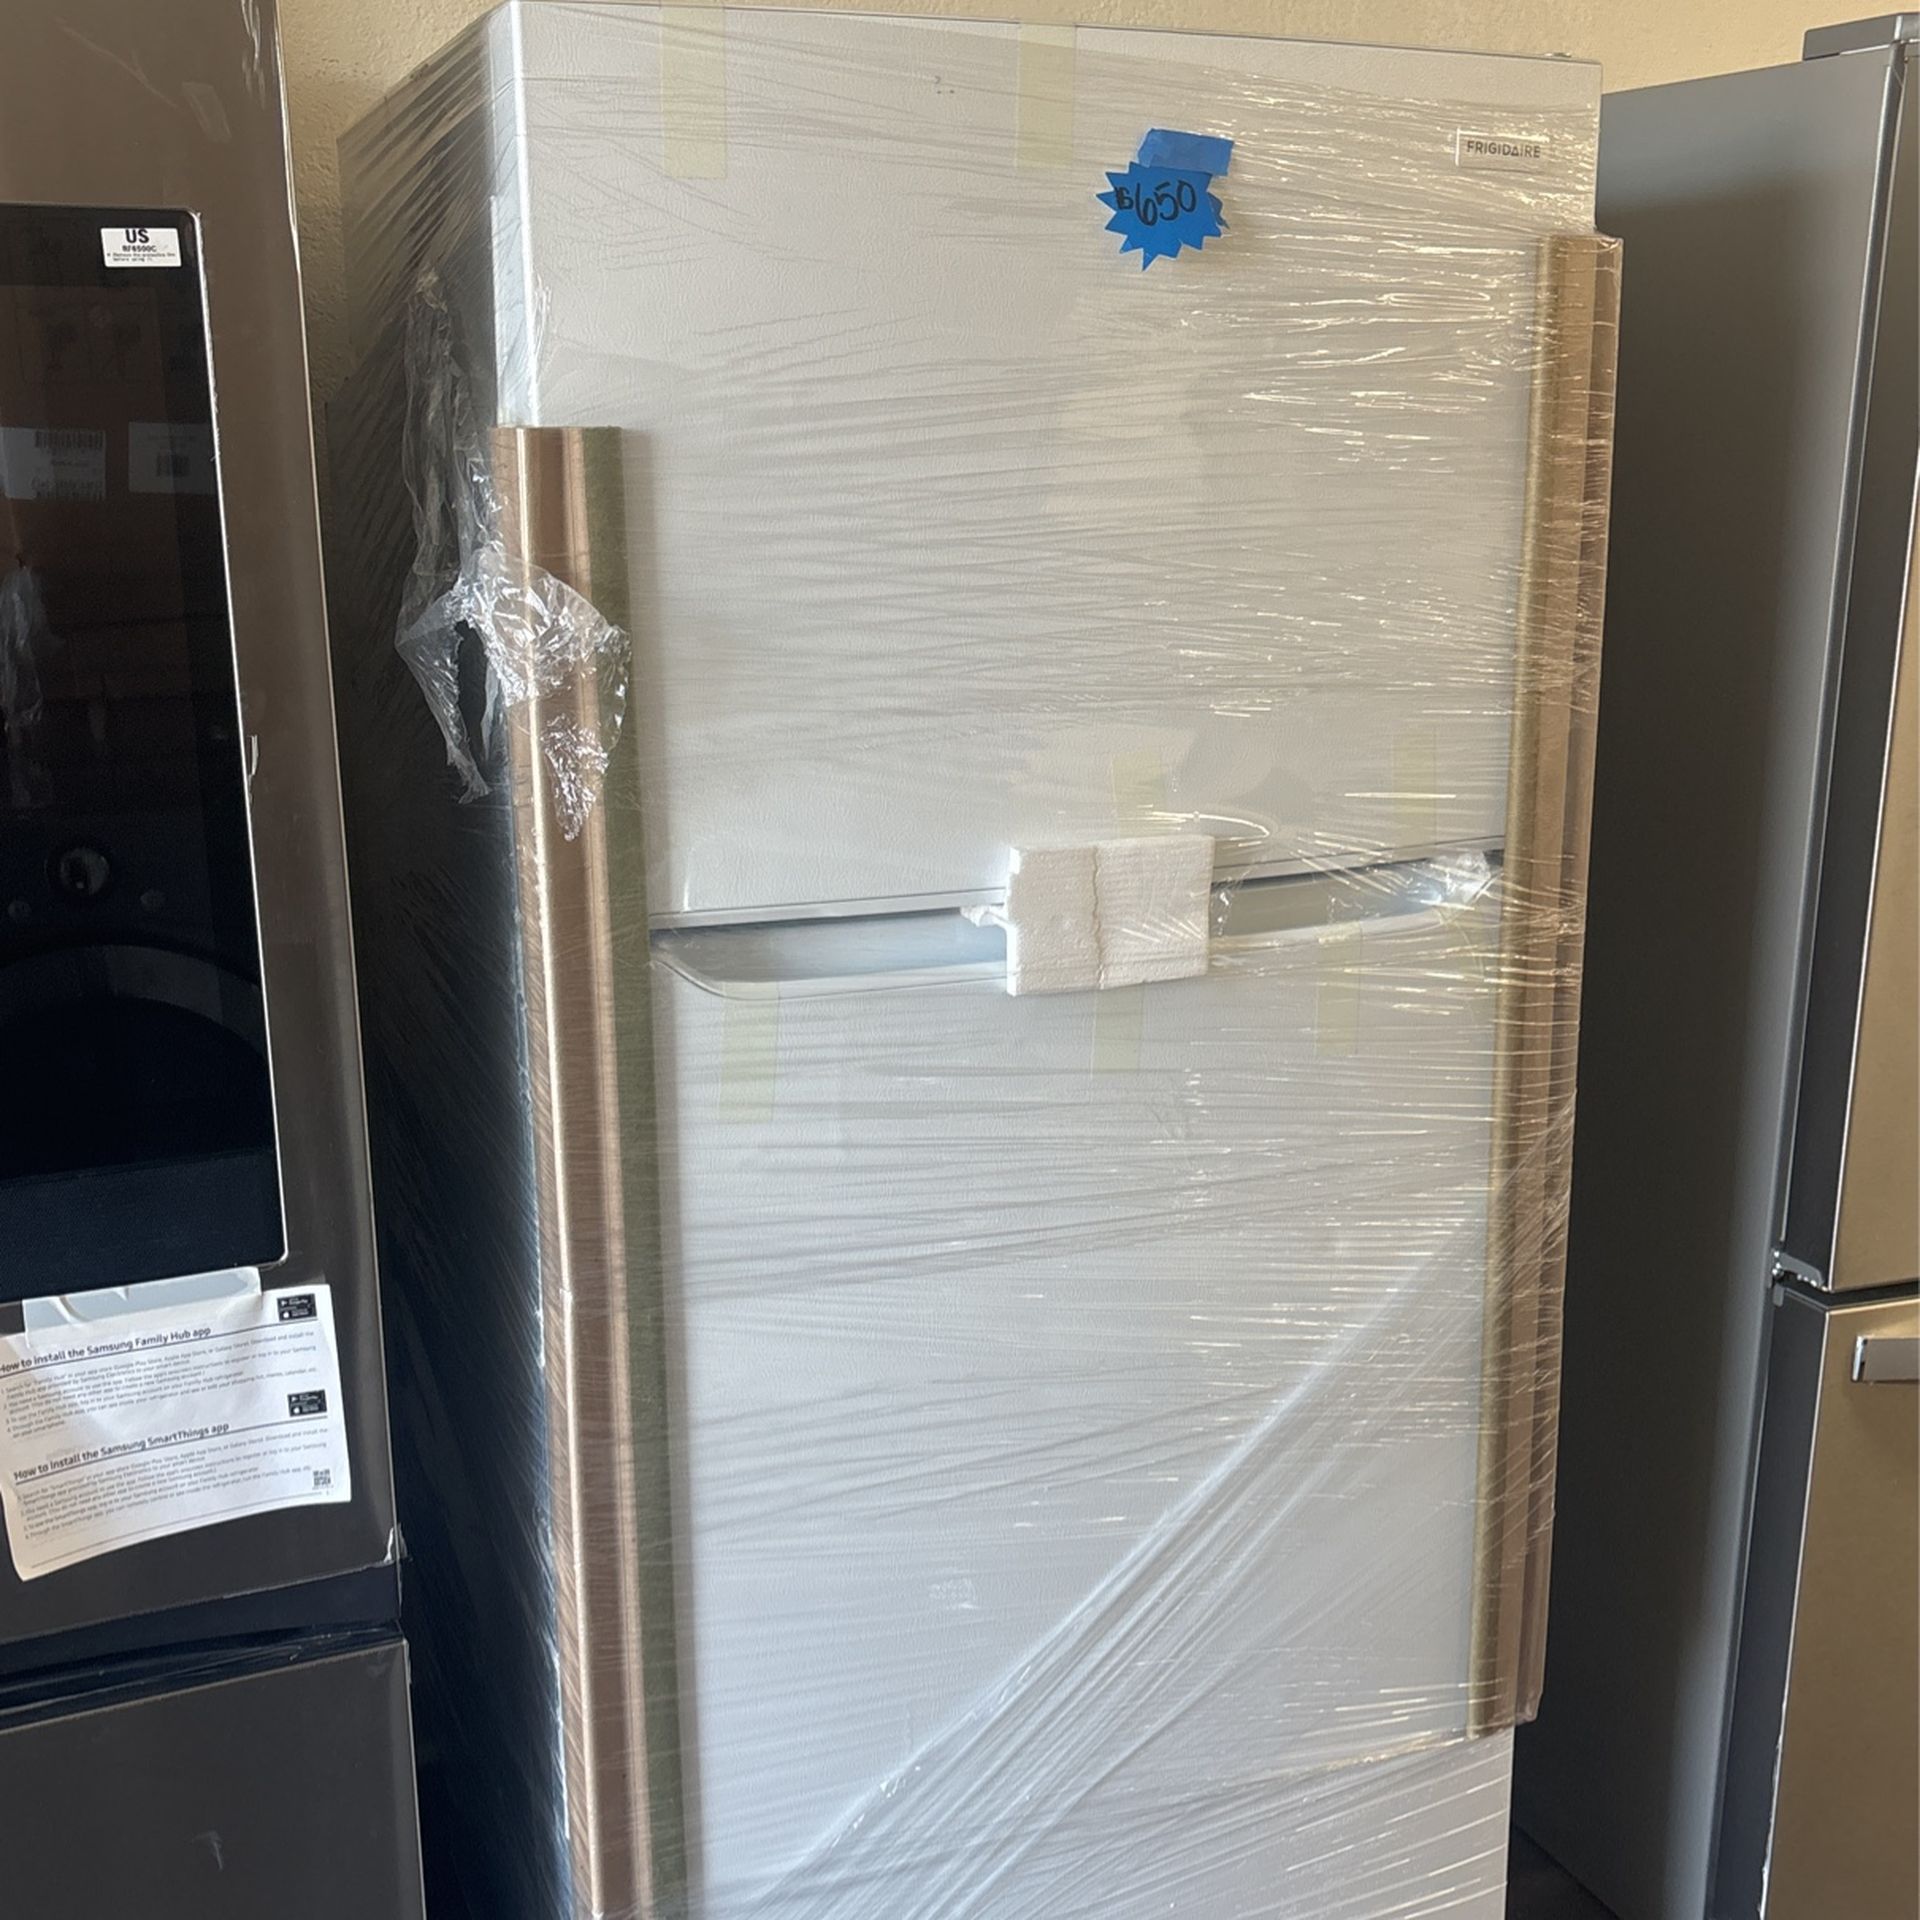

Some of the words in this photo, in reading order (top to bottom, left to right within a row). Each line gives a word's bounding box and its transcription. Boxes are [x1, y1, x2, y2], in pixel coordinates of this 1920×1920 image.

[1466, 140, 1541, 158] FRIGIDAIRE
[1114, 180, 1197, 226] $650
[125, 228, 150, 243] US
[20, 1359, 32, 1367] to
[34, 1351, 65, 1363] install
[67, 1347, 84, 1357] the
[87, 1339, 133, 1353] Samsung
[135, 1334, 169, 1346] Family
[170, 1329, 190, 1340] Hub
[192, 1327, 211, 1338] app
[13, 1466, 35, 1480] How
[37, 1462, 48, 1473] to
[50, 1454, 80, 1469] install
[81, 1449, 99, 1460] the
[100, 1438, 146, 1453] Samsung
[147, 1428, 209, 1445] SmartThings
[211, 1422, 229, 1434] app
